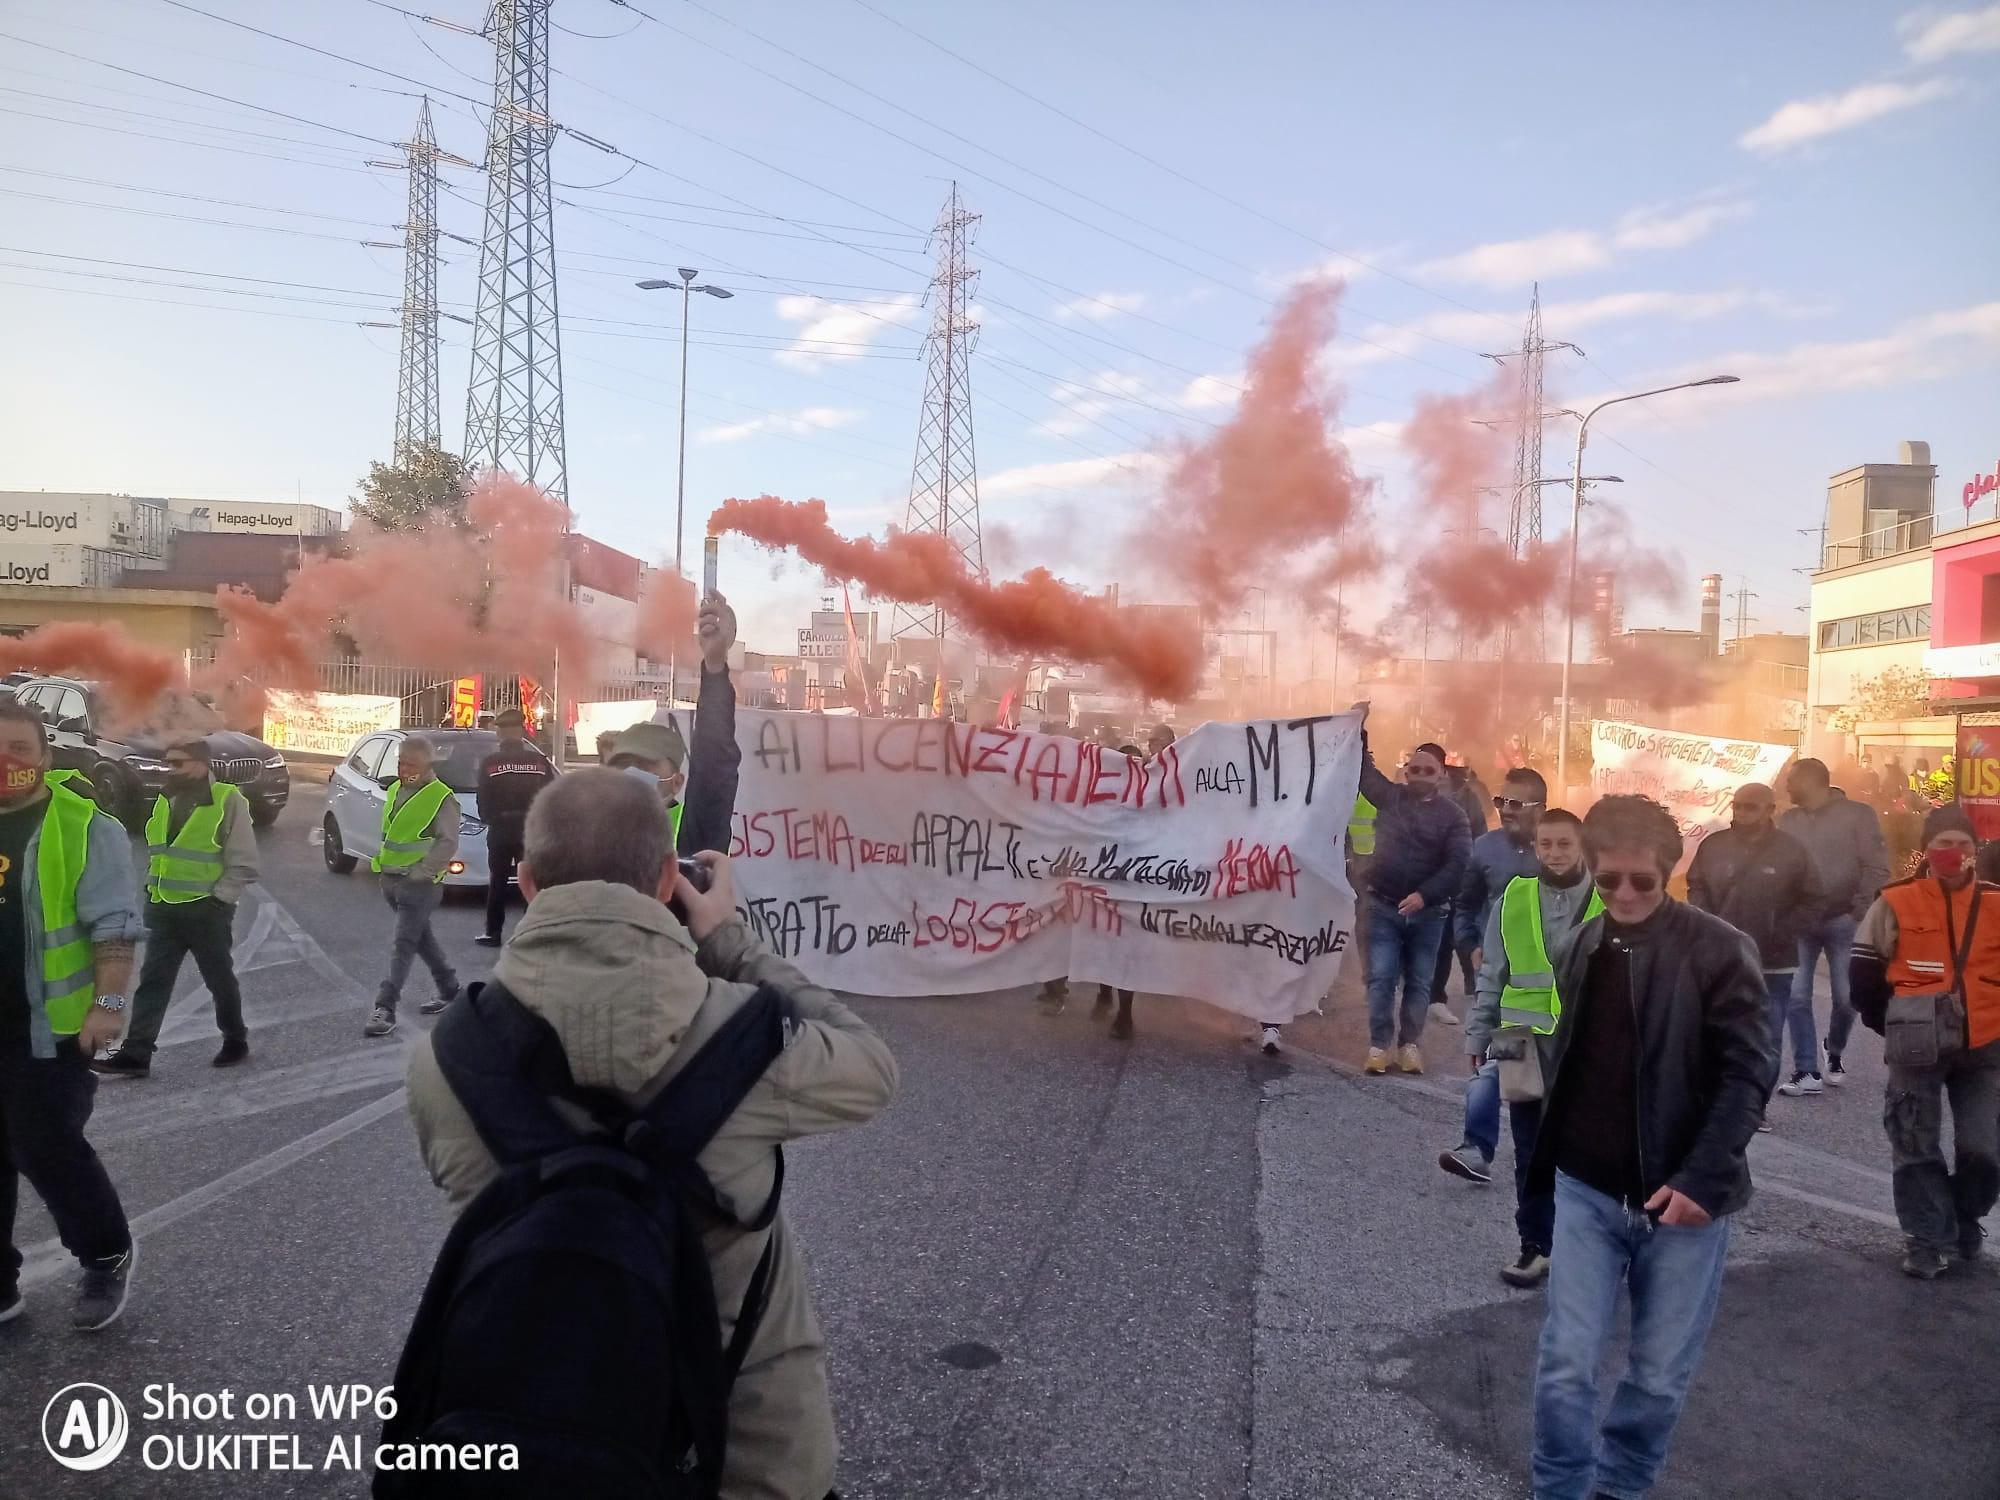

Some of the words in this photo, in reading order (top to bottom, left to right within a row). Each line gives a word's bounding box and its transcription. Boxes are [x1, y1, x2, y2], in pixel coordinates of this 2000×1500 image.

[217, 511, 293, 528] Hapag-Lloyd
[8, 768, 36, 787] USB
[1196, 761, 1246, 794] ALLA
[859, 838, 908, 867] DEGLI
[911, 811, 1025, 881] APPALTI
[1212, 837, 1301, 899] MERDA
[867, 919, 911, 948] DELLA
